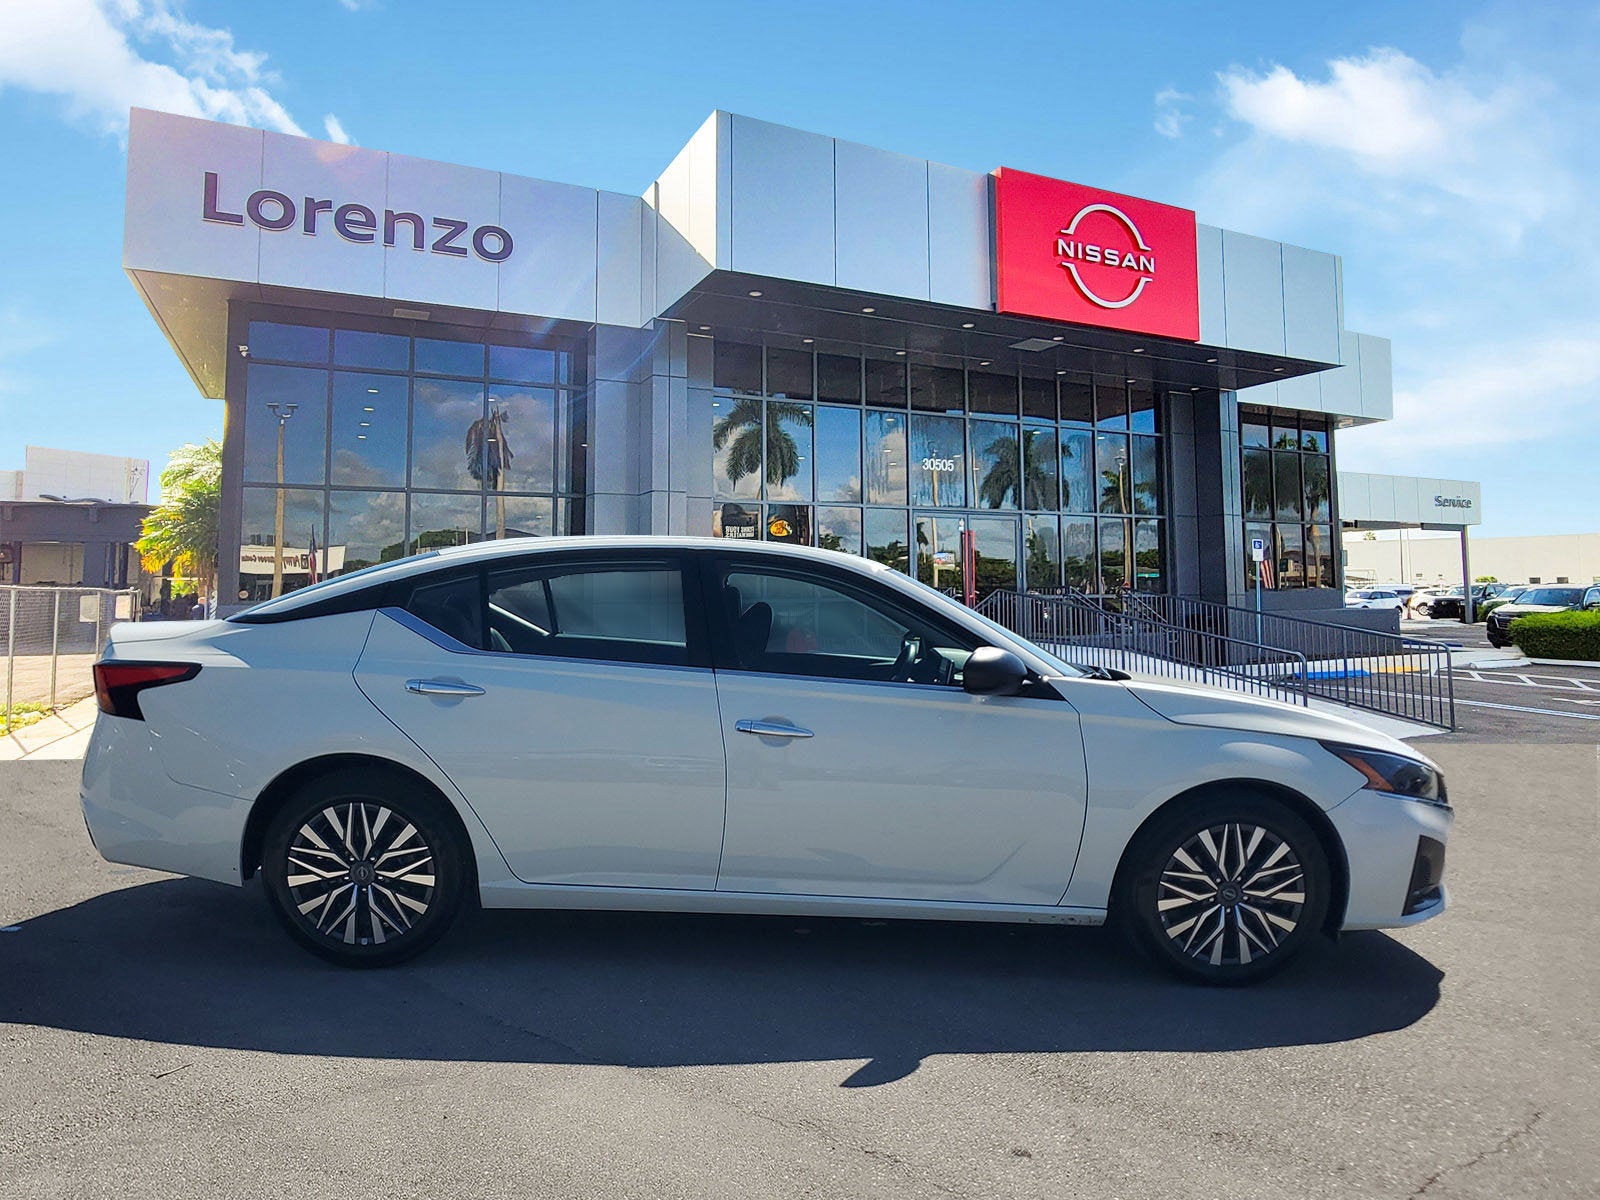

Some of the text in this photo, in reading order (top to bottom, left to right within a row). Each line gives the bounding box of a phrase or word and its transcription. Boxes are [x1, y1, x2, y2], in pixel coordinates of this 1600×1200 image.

[203, 171, 514, 263] Lorenzo
[1057, 238, 1155, 273] NISSAN
[922, 457, 955, 472] 30505
[1434, 495, 1472, 509] Service
